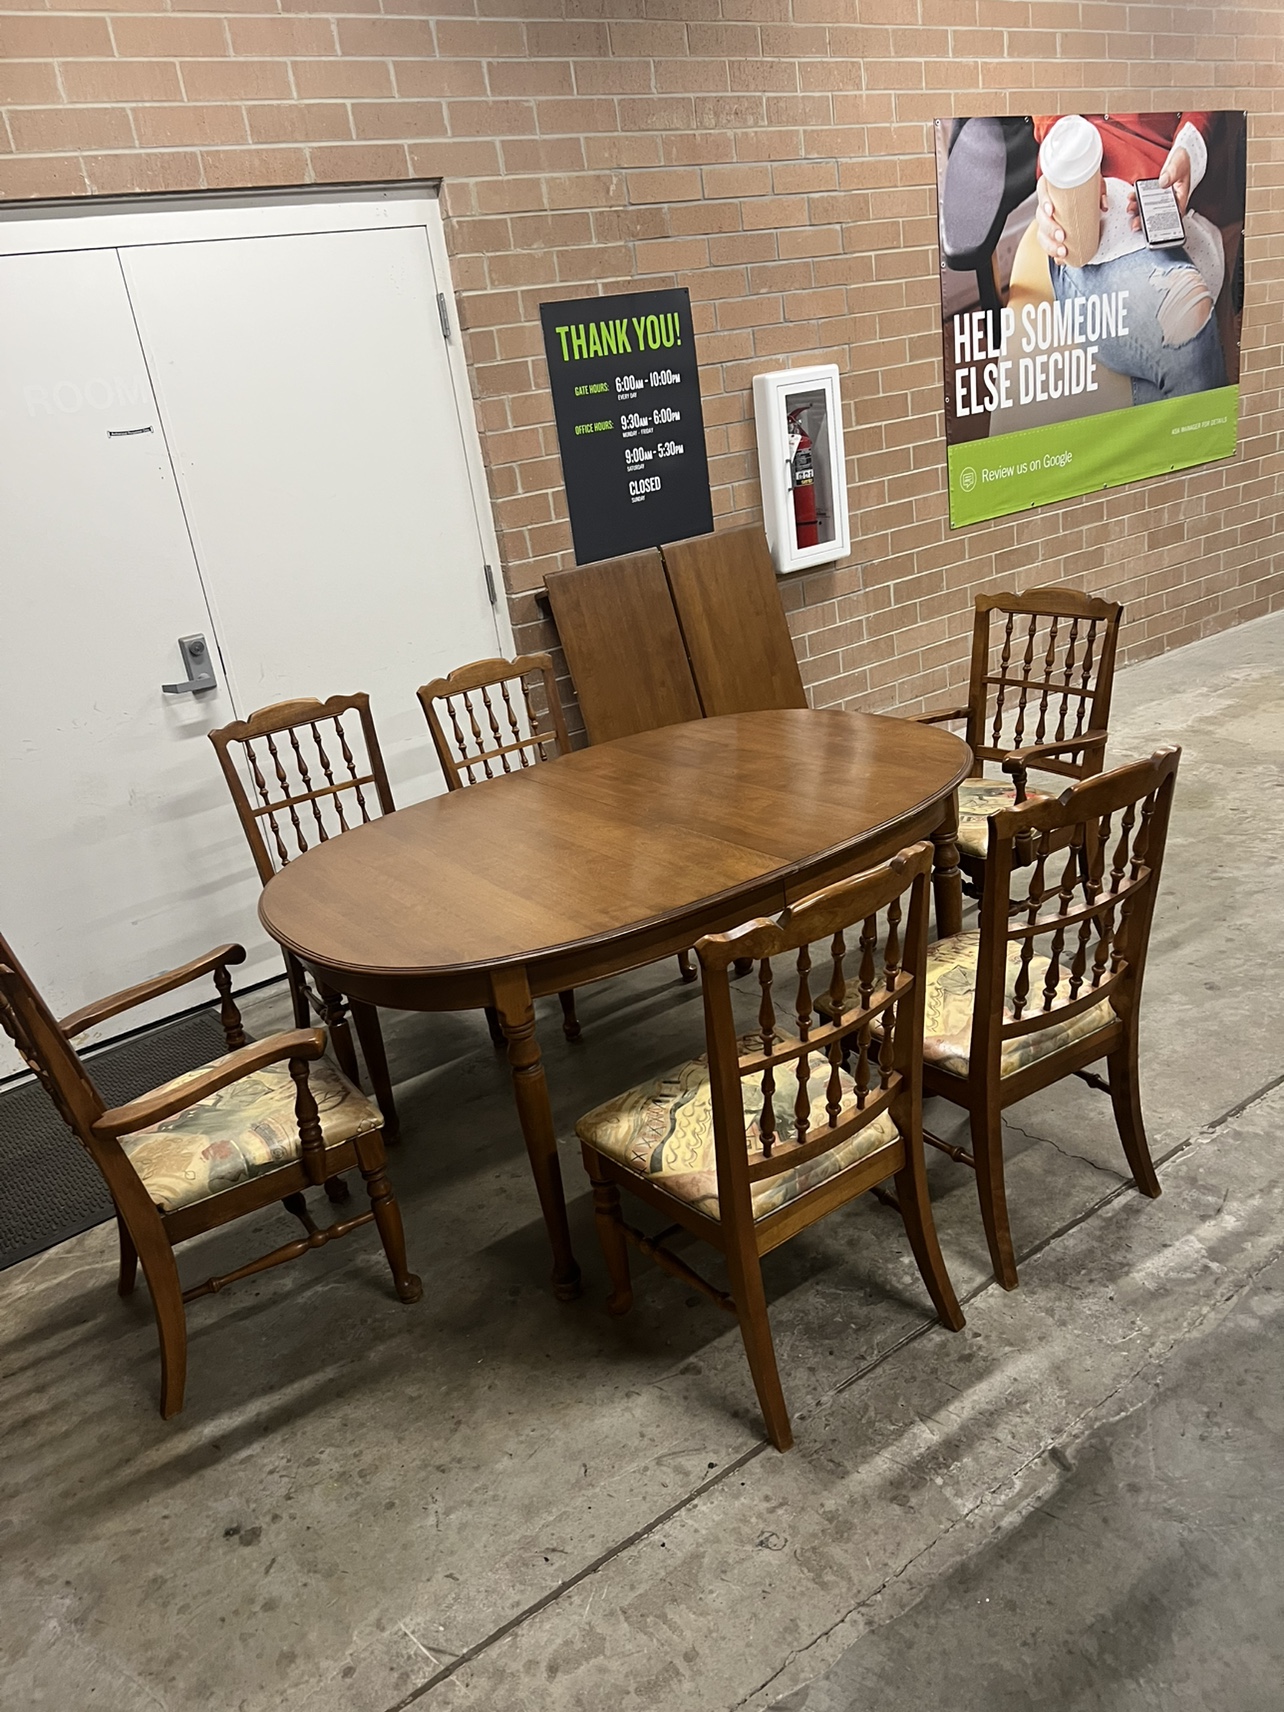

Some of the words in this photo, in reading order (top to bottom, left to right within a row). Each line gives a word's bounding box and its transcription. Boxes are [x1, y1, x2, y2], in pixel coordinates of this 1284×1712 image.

[555, 318, 632, 362] THANK
[632, 312, 682, 351] YOU!
[953, 307, 1016, 364] HELP
[1021, 290, 1130, 353] SOMEONE
[23, 374, 150, 417] ROOM
[574, 385, 589, 396] GATE
[589, 382, 610, 394] HOURS:
[615, 375, 644, 393] 6:00AM
[649, 369, 681, 387] 10:00PM
[617, 393, 630, 401] EVERY
[955, 362, 1014, 418] ELSE
[1019, 345, 1099, 406] DECIDE
[575, 423, 594, 436] OFFICE
[594, 420, 615, 432] HOURS:
[620, 412, 649, 430] 9:30AM
[653, 407, 681, 425] 6:00PM
[625, 446, 653, 464] 9:00AM
[657, 441, 684, 458] 5:30PM
[981, 465, 1015, 483] Review
[1016, 462, 1028, 475] us
[1029, 459, 1041, 472] on
[1043, 450, 1073, 468] Google
[629, 476, 662, 496] CLOSED
